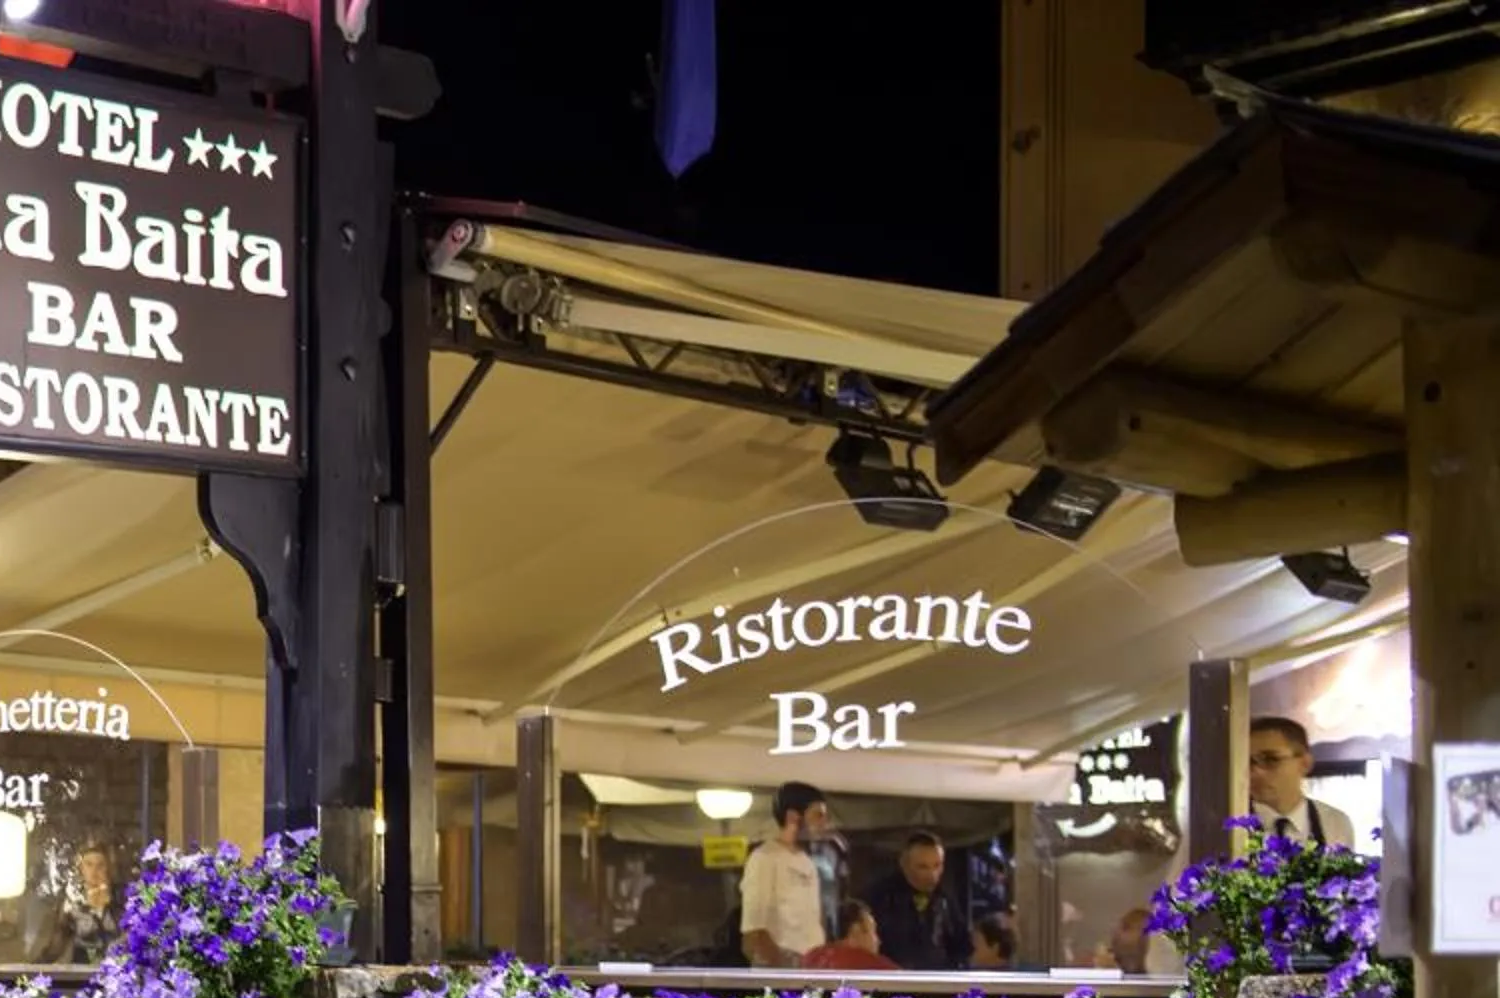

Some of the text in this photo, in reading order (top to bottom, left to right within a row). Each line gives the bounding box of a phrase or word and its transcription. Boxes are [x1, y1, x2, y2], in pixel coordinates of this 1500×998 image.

[75, 180, 288, 298] Baita
[26, 280, 183, 363] BAR
[649, 588, 1033, 693] Ristorante
[768, 691, 916, 755] Bar
